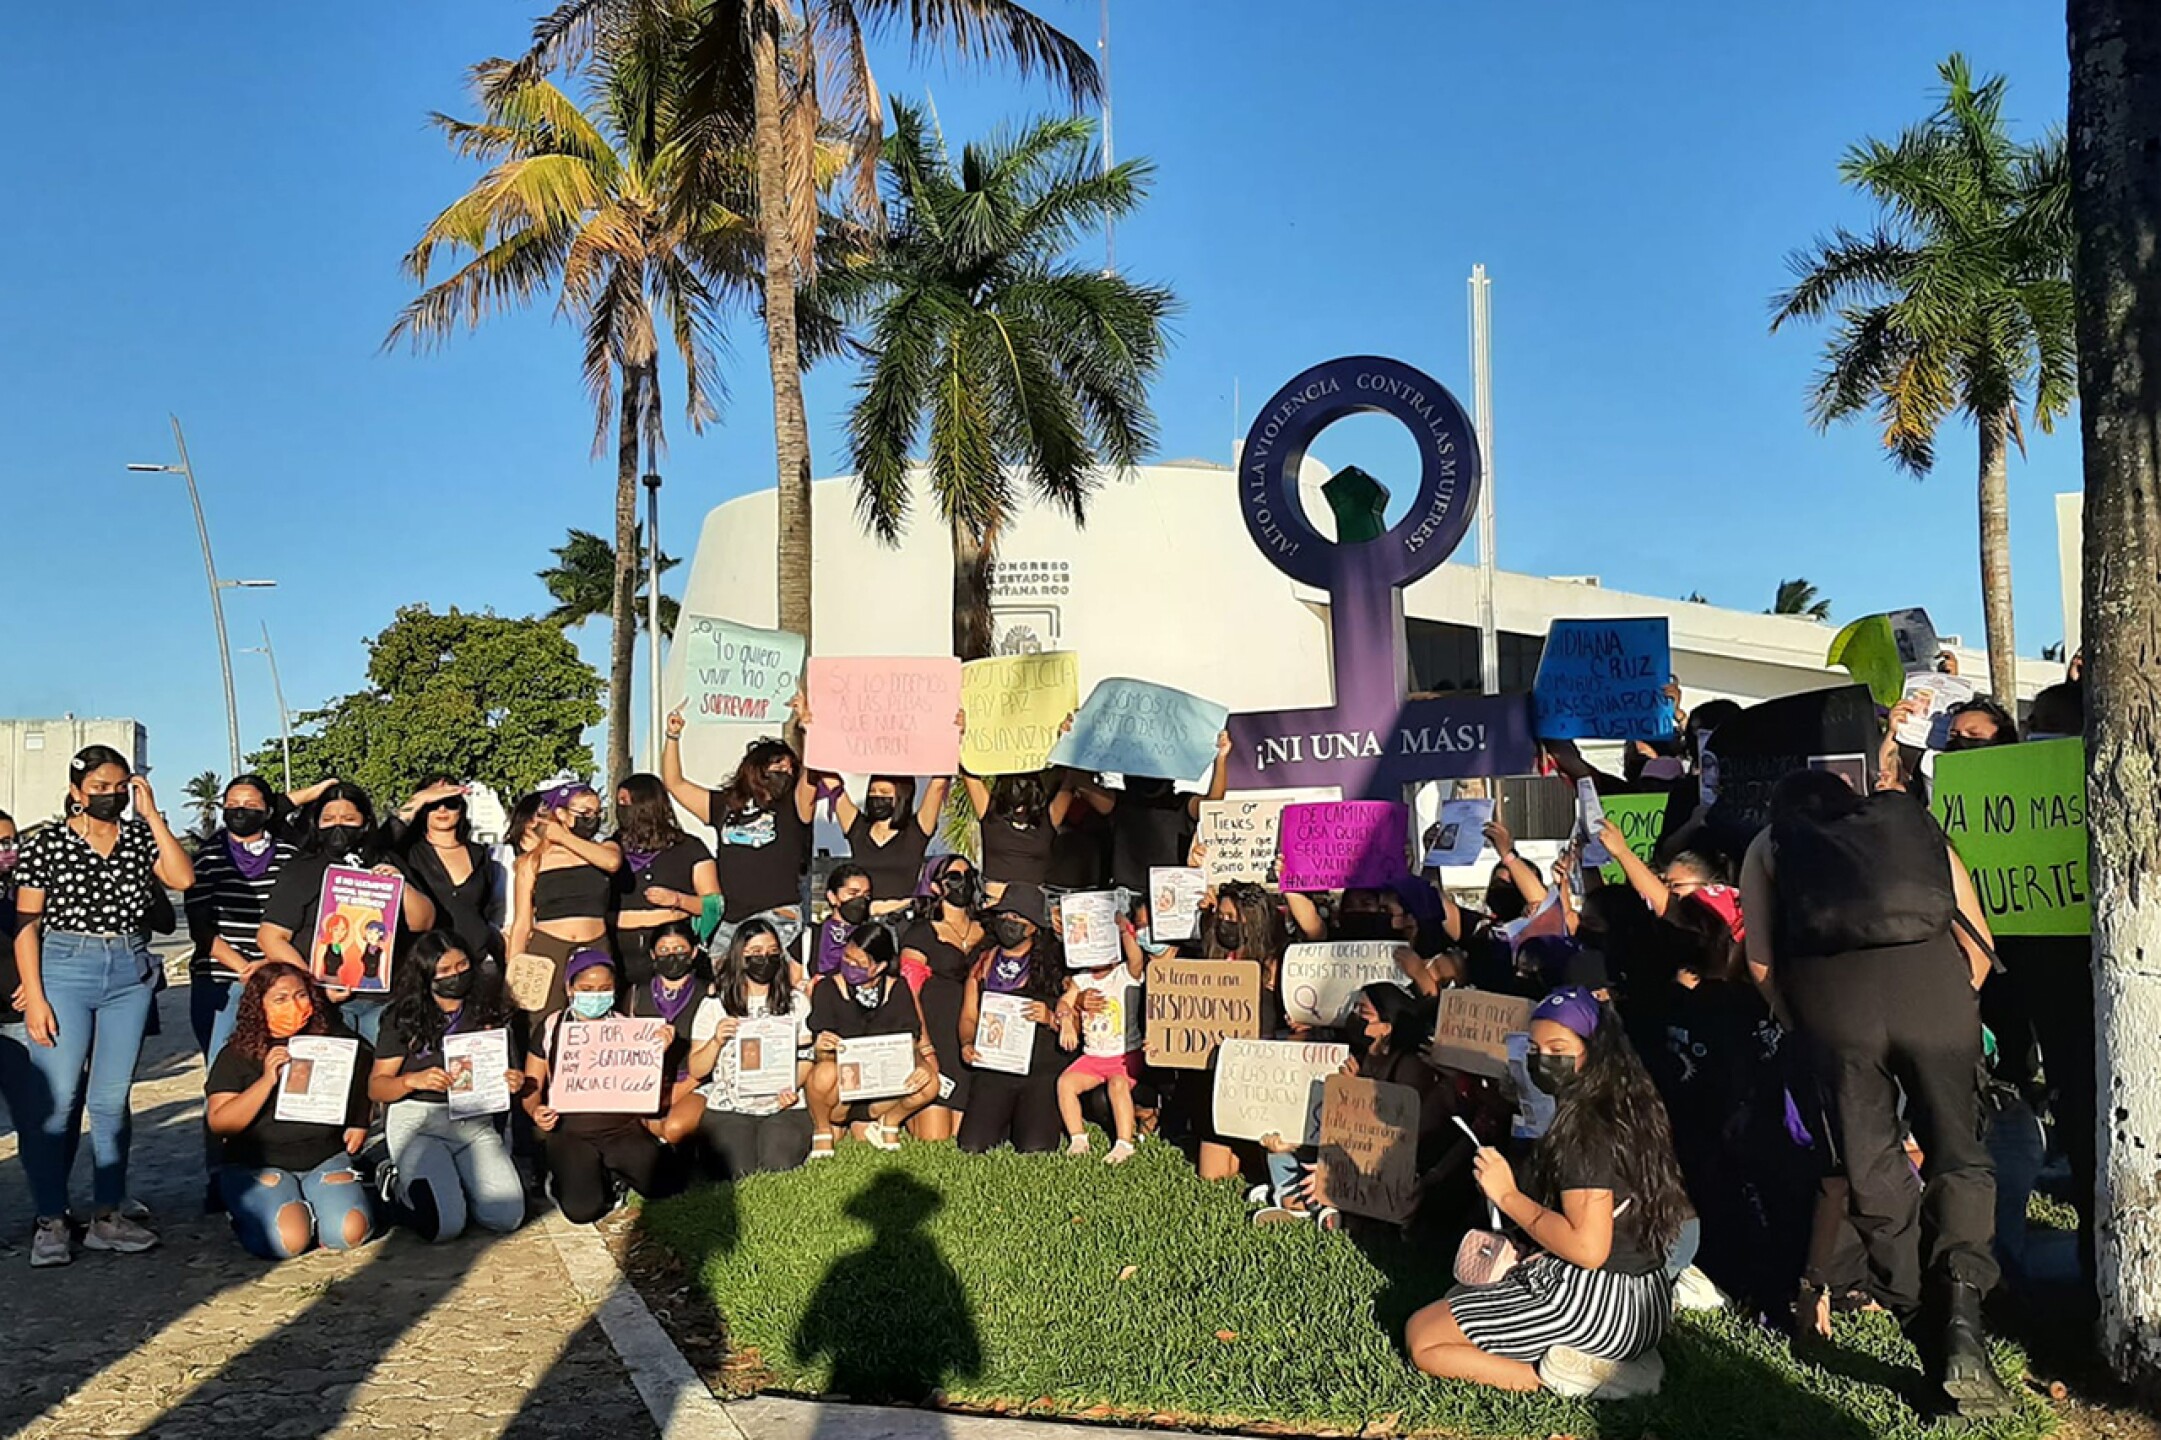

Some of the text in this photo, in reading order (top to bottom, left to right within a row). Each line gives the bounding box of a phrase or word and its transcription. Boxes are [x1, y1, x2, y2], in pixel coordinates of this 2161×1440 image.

[1250, 373, 1459, 557] ¡ALTO A LA VIOLENCIA CONTRA LAS MUJERES!
[997, 561, 1069, 572] ONGRESO
[1041, 586, 1069, 595] ROO
[1590, 655, 1656, 679] CRUZ
[1000, 690, 1032, 716] PAZ
[1256, 716, 1487, 771] ¡NI UNA MÁS!
[1300, 806, 1317, 824] DE
[1942, 794, 2085, 834] YA NO MAS
[1297, 825, 1330, 841] CASA
[1218, 846, 1244, 859] desde
[1294, 842, 1321, 857] SER
[1329, 944, 1370, 958] LUCHO
[1147, 993, 1252, 1023] RESPONDEMOS
[566, 1025, 590, 1046] ES
[600, 1024, 624, 1043] POR
[1160, 1027, 1226, 1053] TODAS
[563, 1048, 654, 1068] QUE GRITAMOS
[561, 1063, 580, 1075] HOY
[1241, 1064, 1268, 1082] LAS
[1272, 1066, 1300, 1087] QUE
[564, 1076, 601, 1092] HACIA
[1219, 1081, 1237, 1100] NO
[1238, 1105, 1269, 1121] VOZ
